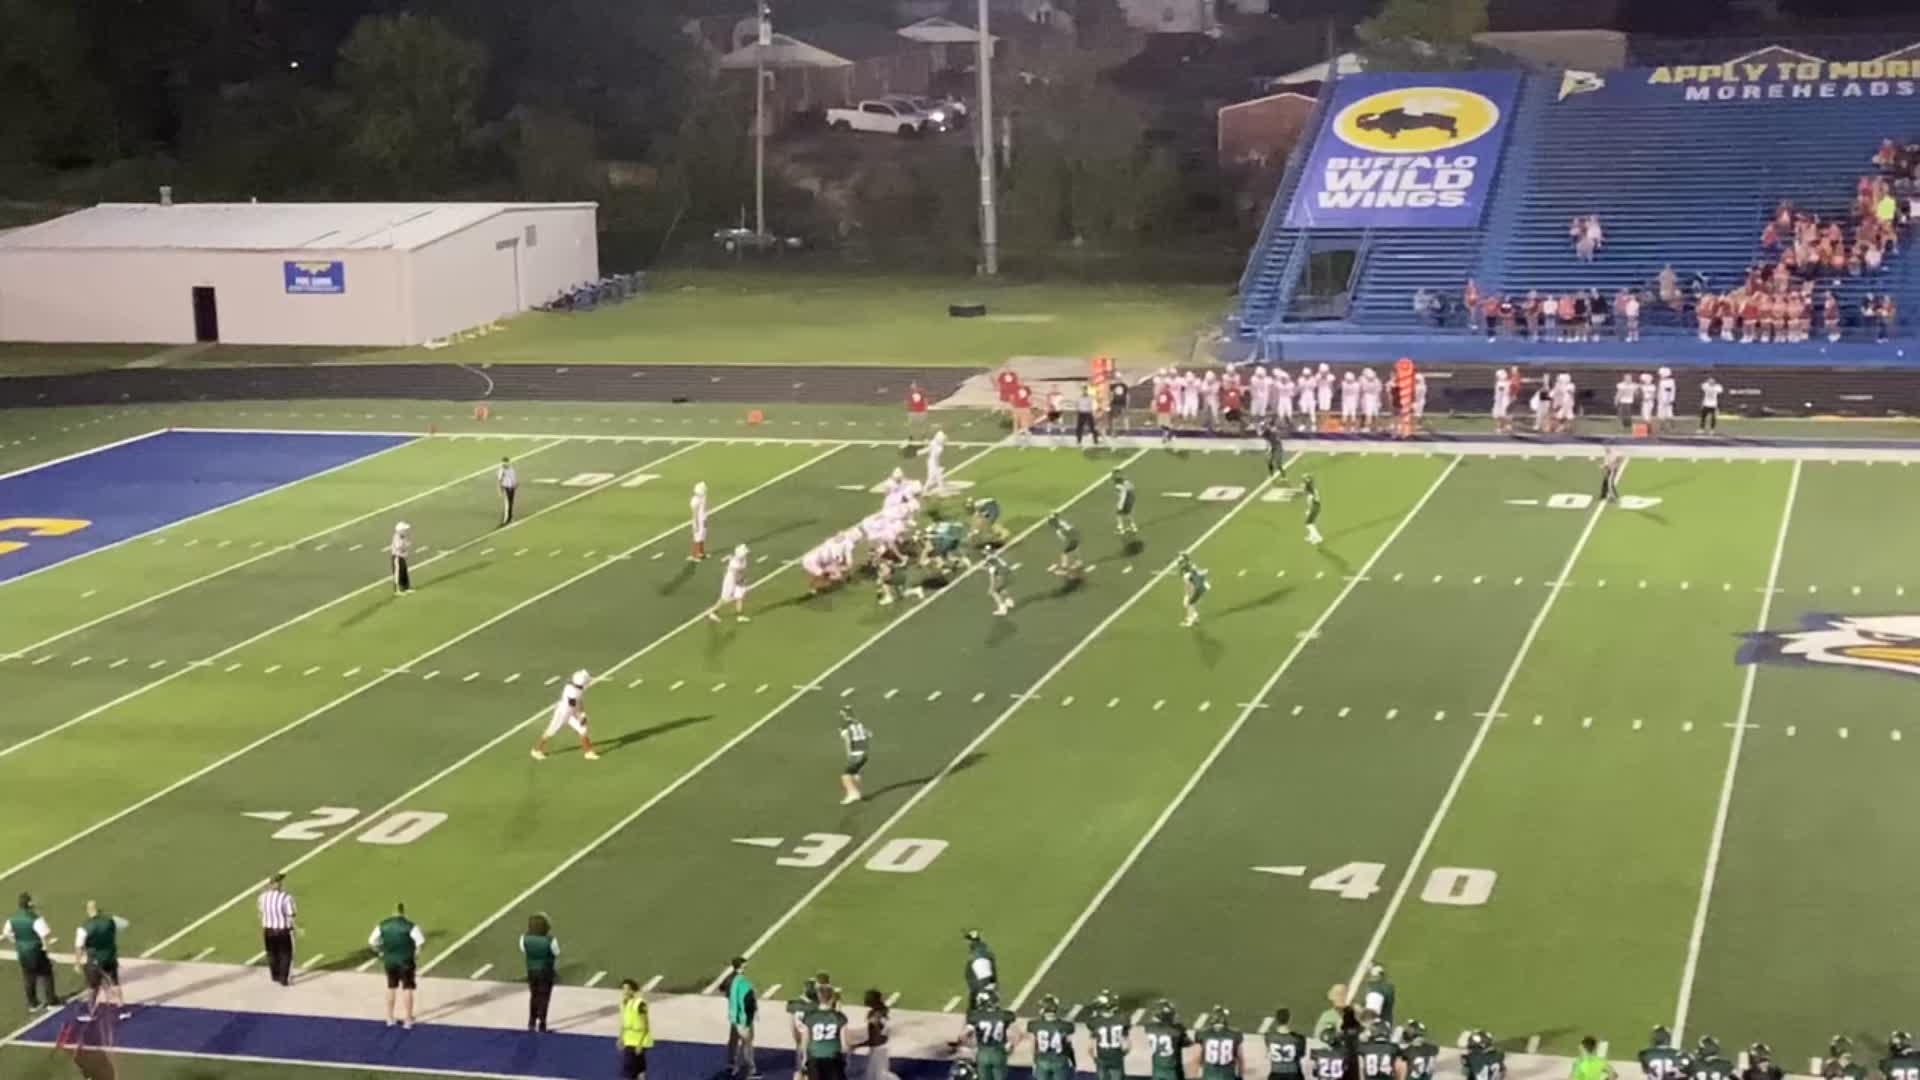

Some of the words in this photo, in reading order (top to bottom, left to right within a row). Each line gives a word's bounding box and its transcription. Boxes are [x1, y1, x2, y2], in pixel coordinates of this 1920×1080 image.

[1648, 63, 1769, 83] APPLY
[1776, 62, 1819, 80] TO
[1327, 155, 1479, 170] BUFFALO
[1325, 168, 1475, 191] WILD
[1317, 190, 1468, 209] WINGS
[271, 806, 448, 844] 20
[776, 832, 949, 872] 30
[1309, 861, 1497, 906] 40
